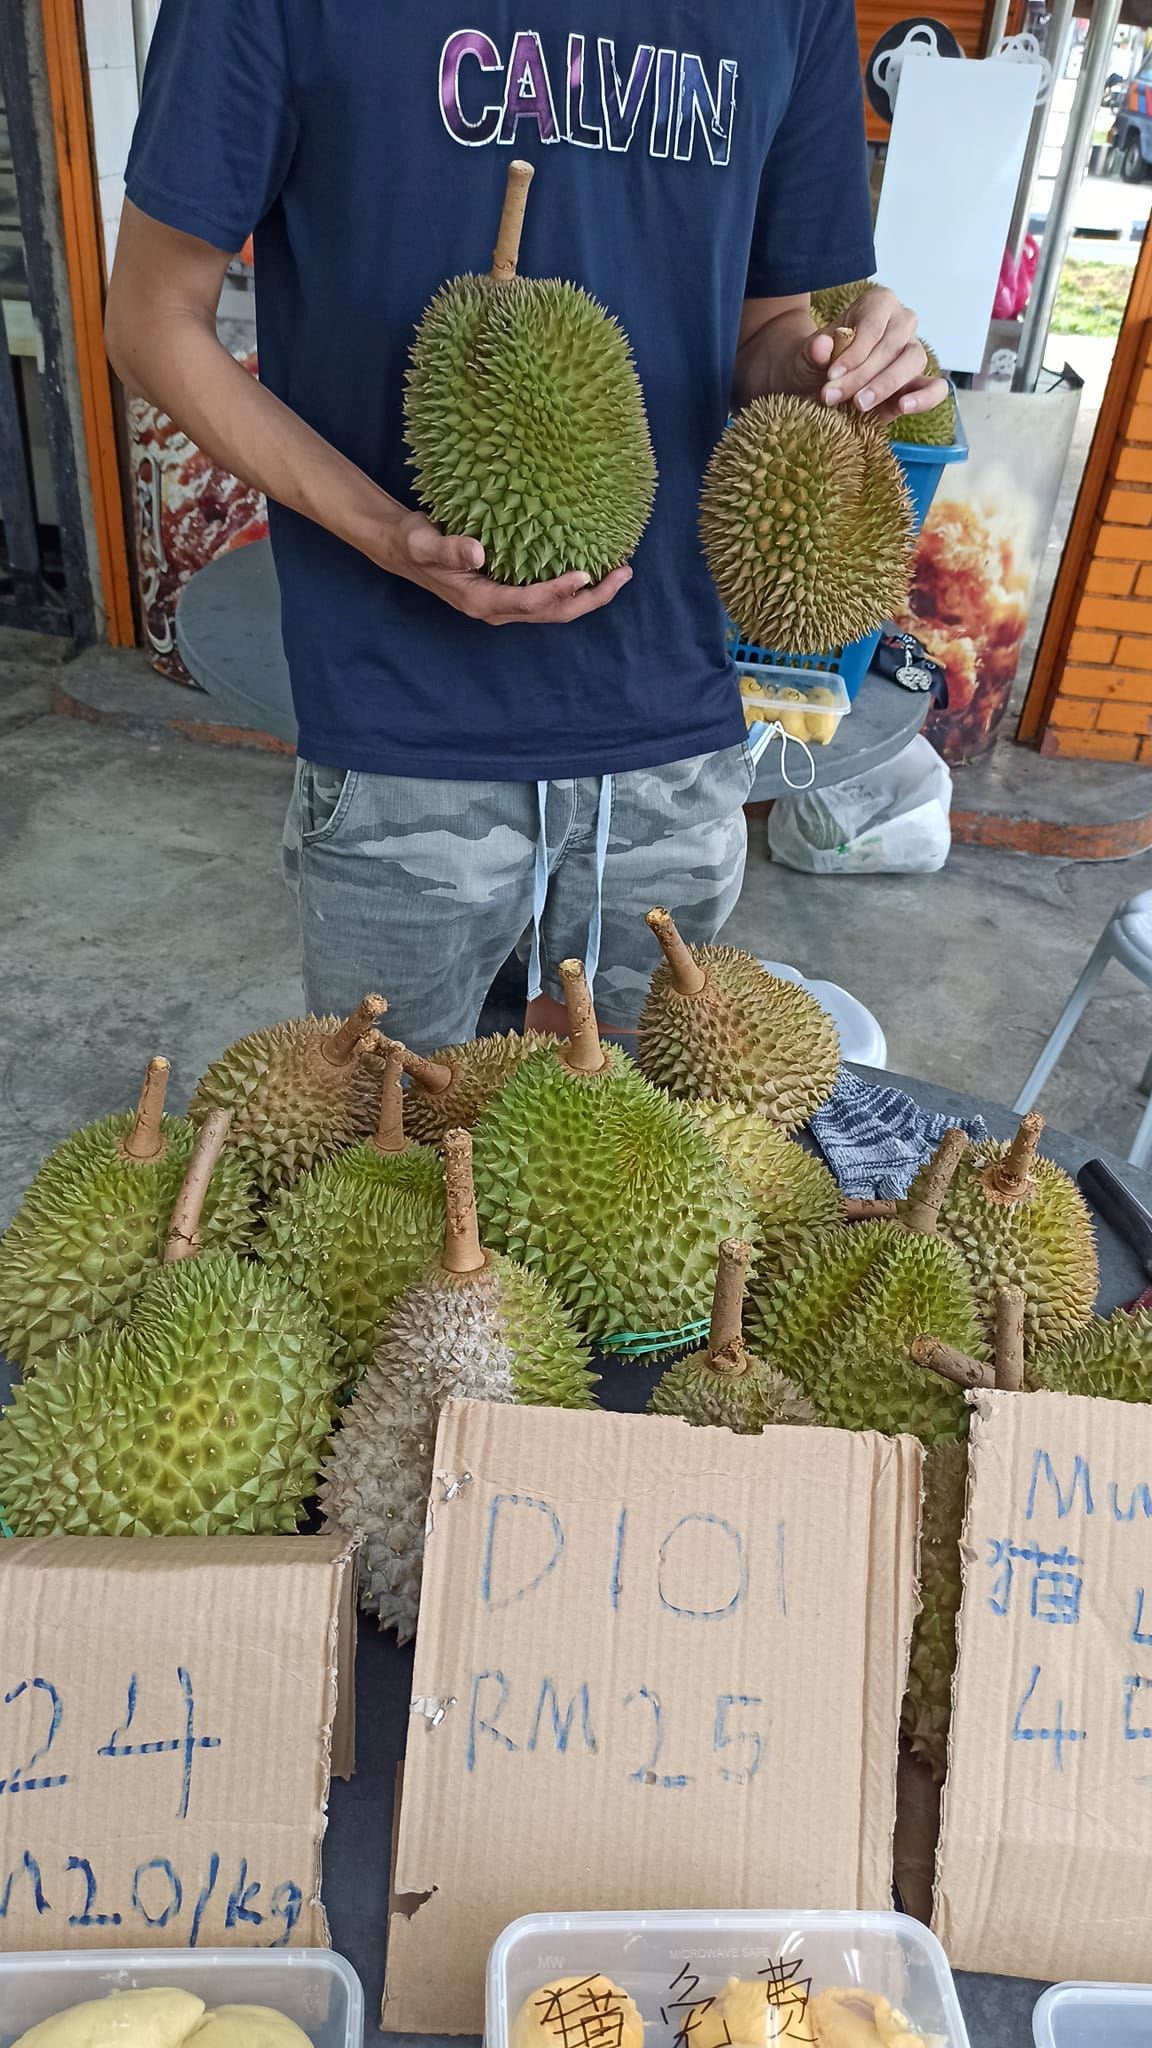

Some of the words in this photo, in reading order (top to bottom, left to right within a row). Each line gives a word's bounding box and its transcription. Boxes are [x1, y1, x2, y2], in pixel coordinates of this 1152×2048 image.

[439, 29, 738, 166] CALVIN
[481, 1495, 788, 1621] D101
[465, 1669, 768, 1788] RM25
[537, 1955, 565, 1969] MW
[669, 1947, 740, 1960] MICROWAVE
[742, 1946, 771, 1959] SAFE
